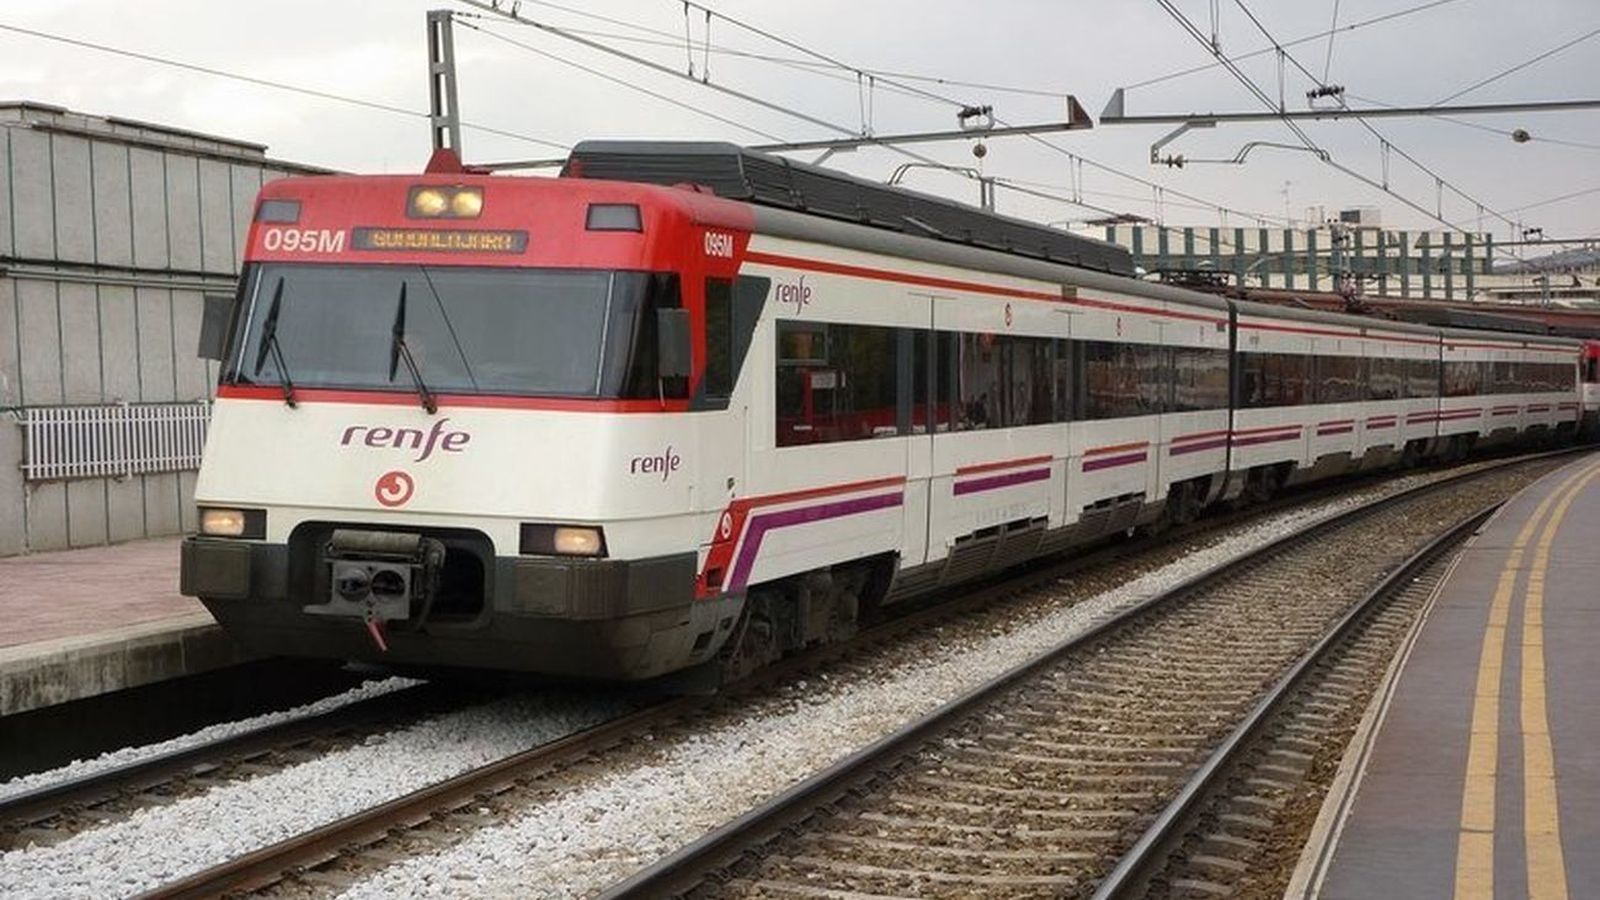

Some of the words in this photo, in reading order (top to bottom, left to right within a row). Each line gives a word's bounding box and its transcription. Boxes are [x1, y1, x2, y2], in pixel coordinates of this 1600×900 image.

[264, 228, 345, 253] 095M
[704, 231, 733, 258] 095M
[775, 275, 811, 315] renfe
[341, 418, 471, 463] renfe
[631, 446, 680, 482] renfe
